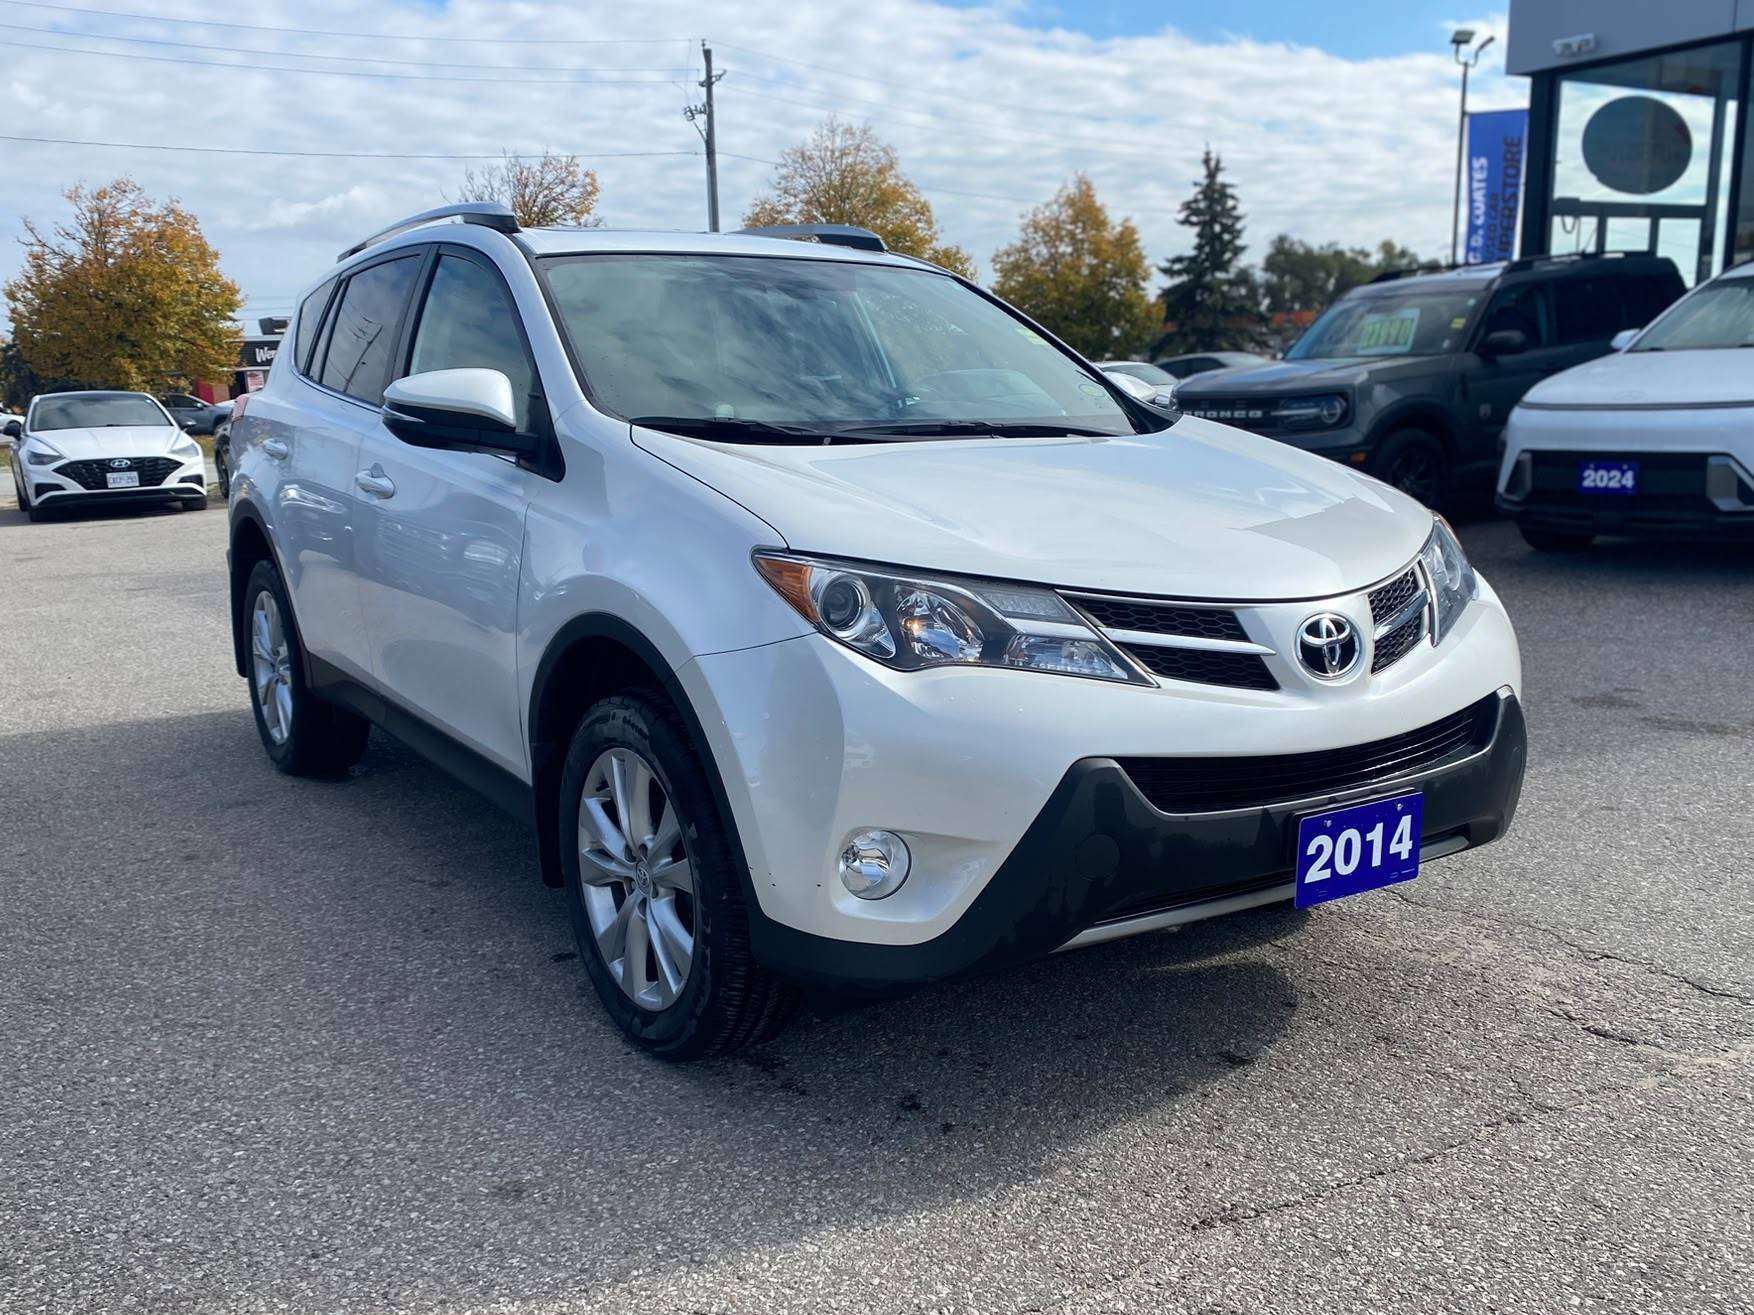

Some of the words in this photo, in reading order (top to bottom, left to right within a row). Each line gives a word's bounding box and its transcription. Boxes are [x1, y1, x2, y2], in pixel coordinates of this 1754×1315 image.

[1498, 136, 1521, 261] UPERSTORE
[1582, 469, 1634, 488] 2024
[1304, 815, 1413, 884] 2014
